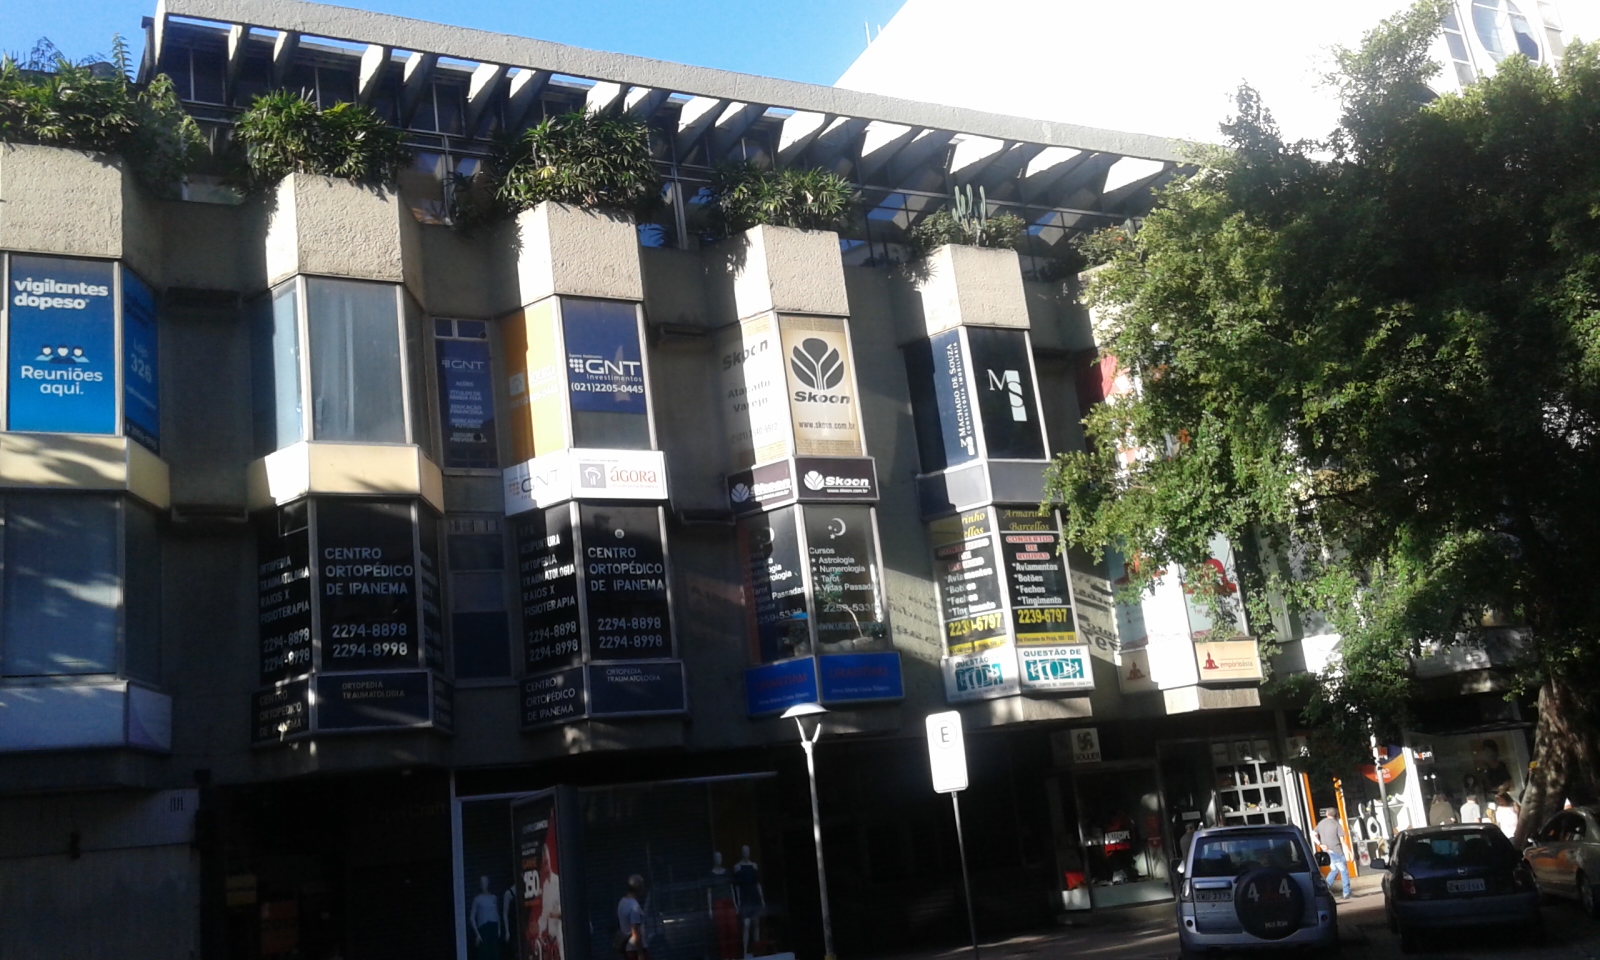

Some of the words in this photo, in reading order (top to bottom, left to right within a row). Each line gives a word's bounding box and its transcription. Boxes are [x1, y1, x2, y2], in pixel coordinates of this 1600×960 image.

[14, 278, 108, 296] vigilantes
[14, 293, 87, 310] dopeso
[451, 360, 484, 370] GNT
[946, 344, 957, 375] SOUZA
[21, 366, 103, 382] Reuniões
[586, 360, 640, 376] GNT
[586, 374, 642, 382] Investimentos
[952, 376, 959, 388] DE
[40, 381, 84, 396] aqui.
[571, 382, 644, 394] (021)2205-0445
[794, 392, 850, 404] Skoon
[955, 390, 966, 436] MACHADO
[825, 476, 869, 486] Skoon
[1009, 522, 1050, 531] Barcellos
[324, 548, 382, 560] CENTRO
[588, 547, 636, 558] CENTRO
[1026, 544, 1038, 552] DE
[818, 556, 854, 565] Astrologia
[325, 562, 414, 578] ORTOPÉDICO
[590, 561, 663, 575] ORTOPÉDICO
[820, 564, 866, 574] Numerologia
[591, 580, 606, 591] DE
[613, 578, 664, 590] IPANEMA
[821, 574, 840, 582] Tarot
[326, 582, 344, 596] DE
[350, 582, 408, 594] IPANEMA
[524, 587, 548, 601] RAIOS
[550, 584, 555, 596] X
[772, 586, 804, 600] Passadas
[821, 584, 842, 592] Vidas
[844, 582, 878, 592] Passada
[284, 589, 290, 600] X
[260, 600, 310, 624] FISIOTERAPIA
[524, 596, 576, 618] FISIOTERAPIA
[824, 604, 875, 612] 2259-533
[1018, 608, 1068, 624] 2239-6797
[598, 617, 662, 630] 2294-8898
[332, 624, 408, 638] 2294-8898
[529, 621, 577, 644] 2294-8898
[599, 635, 663, 648] 2294-8998
[332, 642, 408, 658] 2294-8998
[530, 638, 578, 662] 2294-8998
[1024, 648, 1067, 657] QUESTÃO
[526, 678, 556, 693] CENTRO
[526, 687, 576, 707] ORTOPÉDICO
[528, 710, 538, 722] DE
[540, 704, 574, 719] IPANEMA
[940, 726, 950, 743] E
[1248, 882, 1260, 902] 4
[1278, 878, 1292, 898] 4
